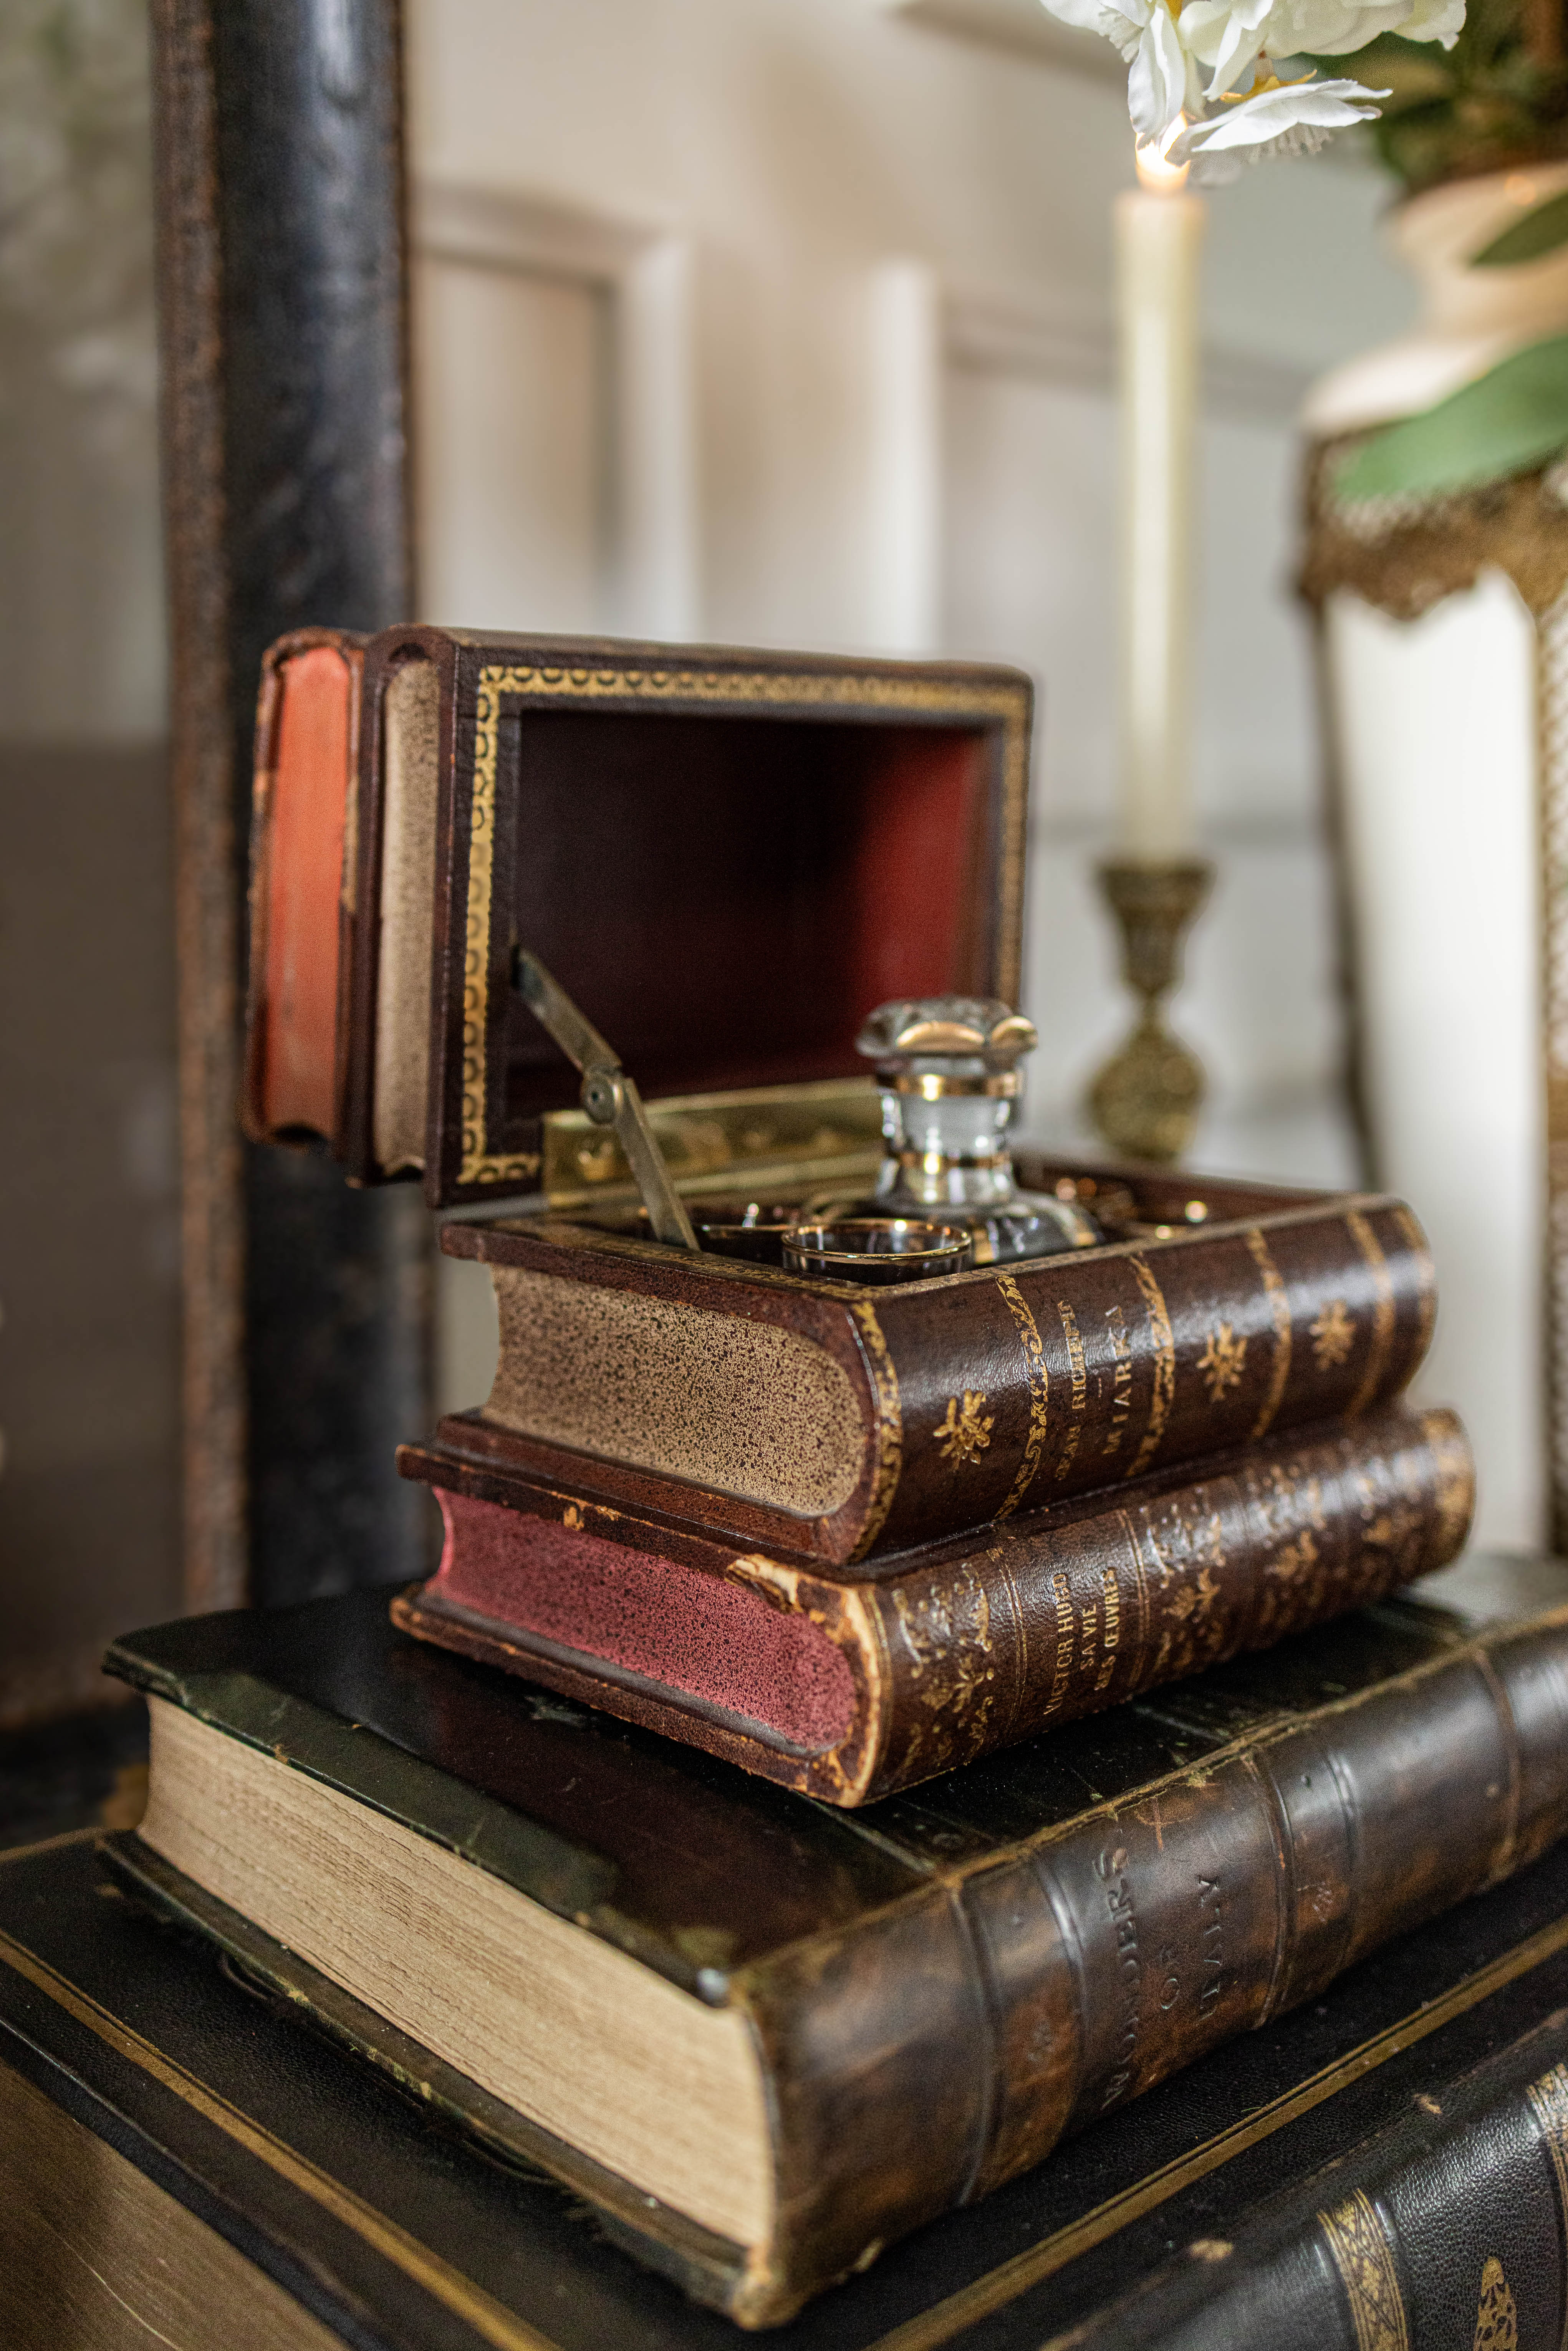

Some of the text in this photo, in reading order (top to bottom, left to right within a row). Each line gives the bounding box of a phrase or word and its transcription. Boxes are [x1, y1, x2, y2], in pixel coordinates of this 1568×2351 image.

[1057, 1300, 1086, 1410] RICHEPIN
[1102, 1305, 1132, 1455] MIARKA
[1043, 1573, 1074, 1715] VICTOR HUGO
[1080, 1603, 1097, 1670] SA VIE
[1092, 1847, 1141, 2111] WONDERS
[1196, 1874, 1223, 2025] ITALY
